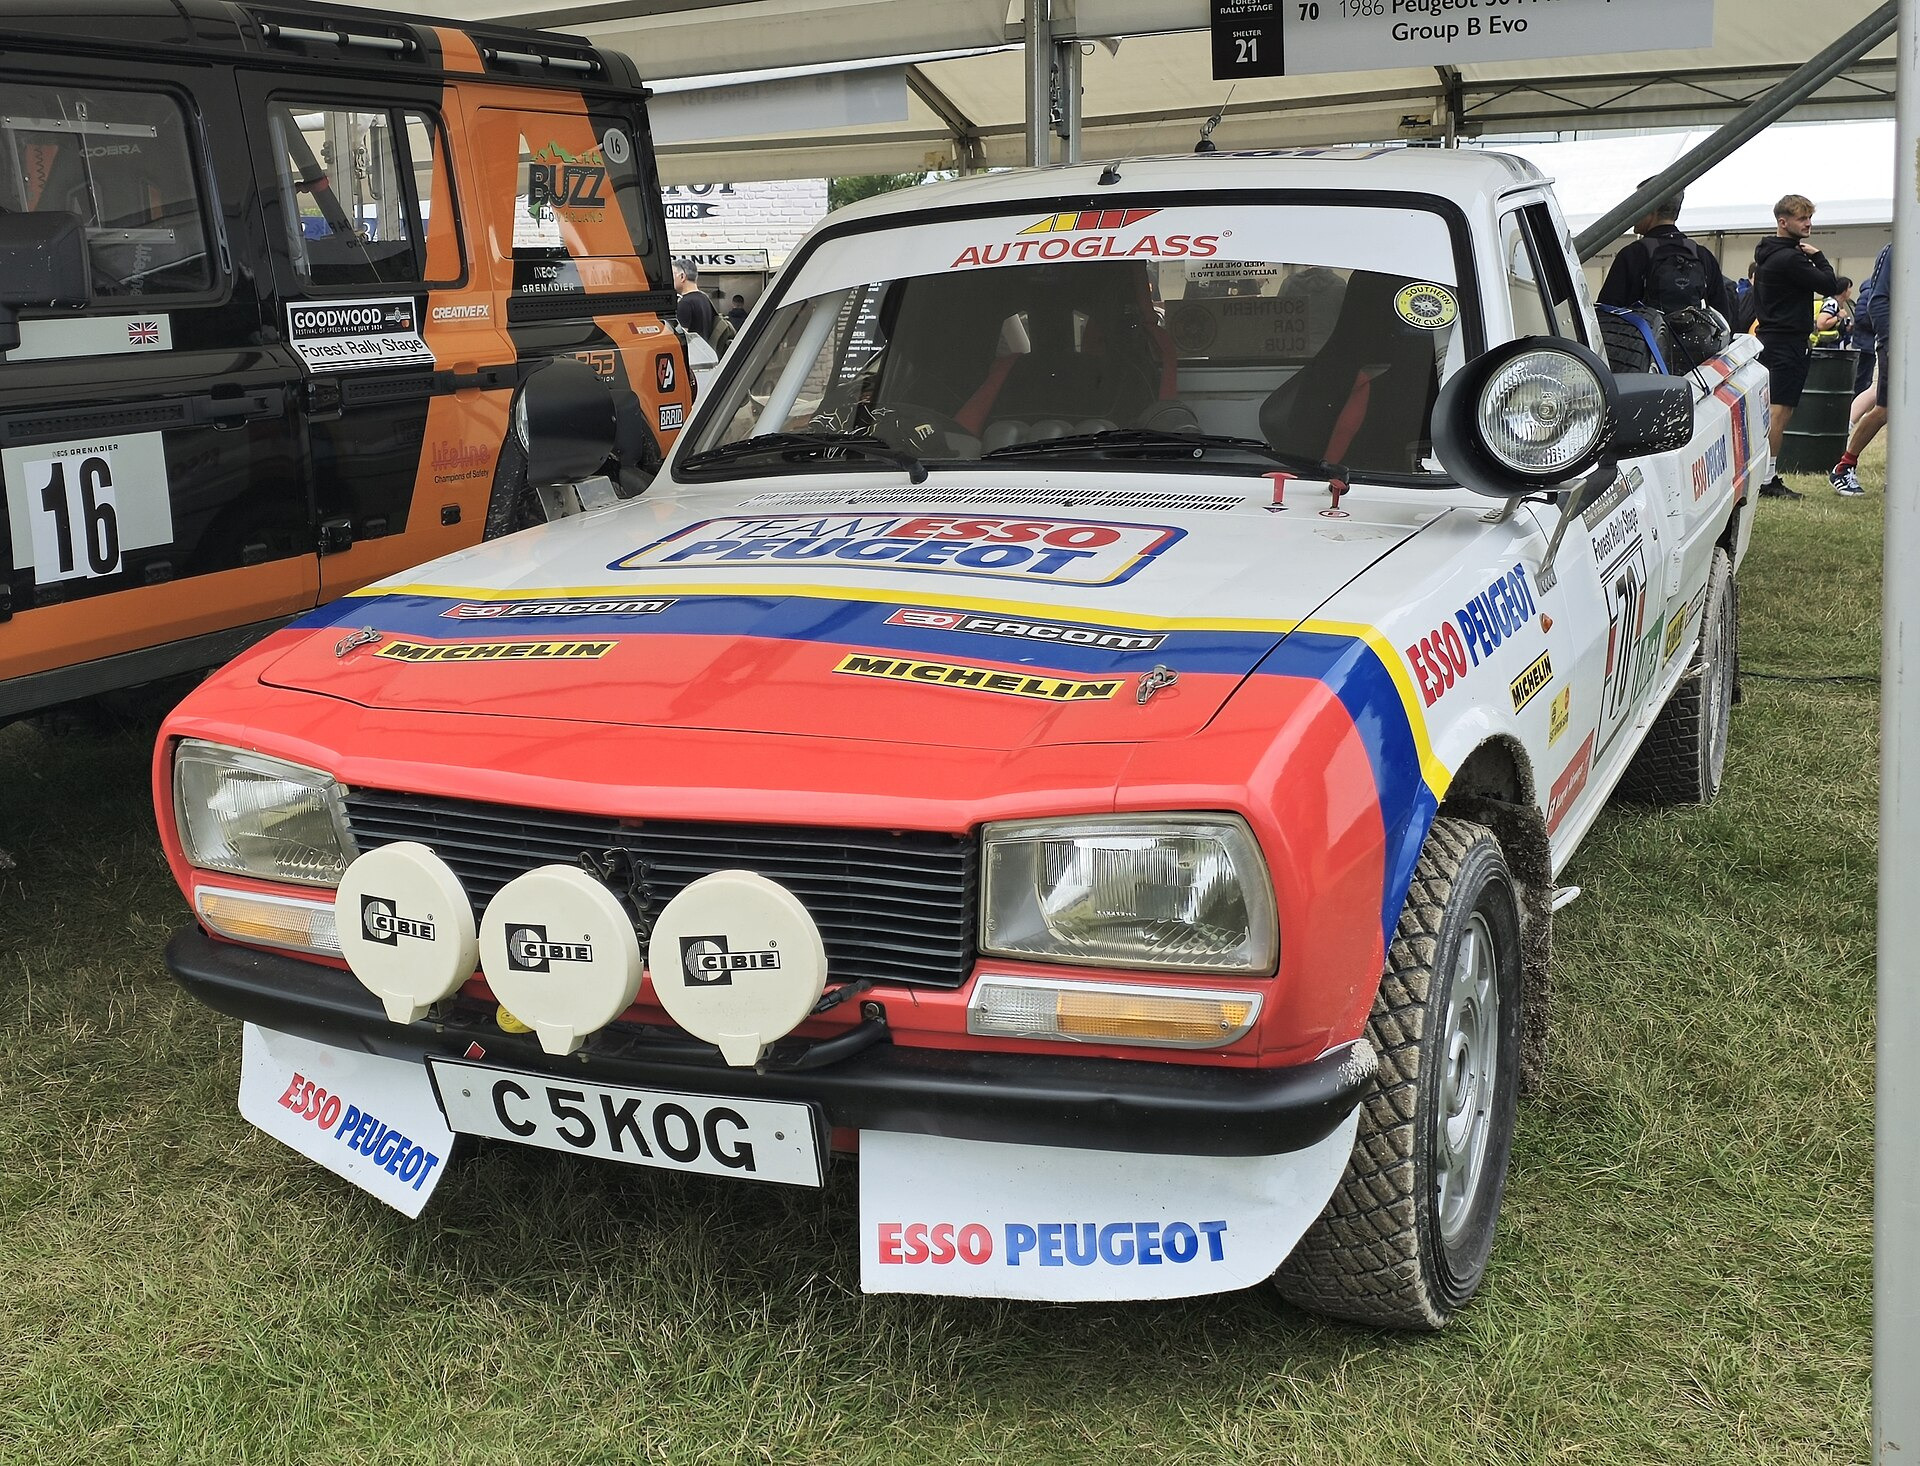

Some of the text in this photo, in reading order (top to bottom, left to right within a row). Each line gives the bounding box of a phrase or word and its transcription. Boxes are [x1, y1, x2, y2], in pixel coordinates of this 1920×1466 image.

[1220, 3, 1274, 14] RALLY STAGE
[1298, 0, 1478, 21] 70 1986 Peugeot
[1232, 29, 1262, 38] SHELTER
[1392, 16, 1528, 43] Group B Evo
[1235, 38, 1258, 63] 21
[610, 137, 621, 155] 16
[529, 163, 606, 209] BUZZ
[666, 204, 699, 218] CHIPS
[950, 235, 1220, 268] AUTOGLASS
[533, 266, 558, 279] INEOS
[522, 282, 575, 293] GRENADIER
[1406, 286, 1452, 305] SOUTHERN
[294, 308, 382, 329] GOODWOOD
[1406, 312, 1445, 325] CAR CLUB
[295, 326, 318, 335] FESTIVAL
[299, 337, 424, 358] Forest Rally Stage
[660, 408, 683, 426] BRAID
[70, 443, 119, 456] GRENADIER
[434, 472, 465, 483] Champions
[472, 468, 489, 479] Safety
[41, 457, 120, 575] 16
[717, 518, 1121, 548] TEAM ESSO
[665, 538, 1097, 574] PEUGEOT
[1592, 527, 1614, 564] Forest
[510, 601, 662, 615] FACOM
[964, 618, 1157, 649] FACOM
[1405, 621, 1468, 709] ESSO
[1454, 562, 1537, 668] PEUGEOT
[383, 642, 612, 660] MICHELIN
[844, 657, 1118, 698] MICHELIN
[1511, 655, 1553, 708] MICHELIN
[375, 915, 433, 939] CIBIE
[524, 943, 589, 961] CIBIE
[702, 952, 777, 970] CIBIE
[277, 1072, 440, 1192] ESSO PEUGEOT
[877, 1219, 1228, 1267] ESSO PEUGEOT
